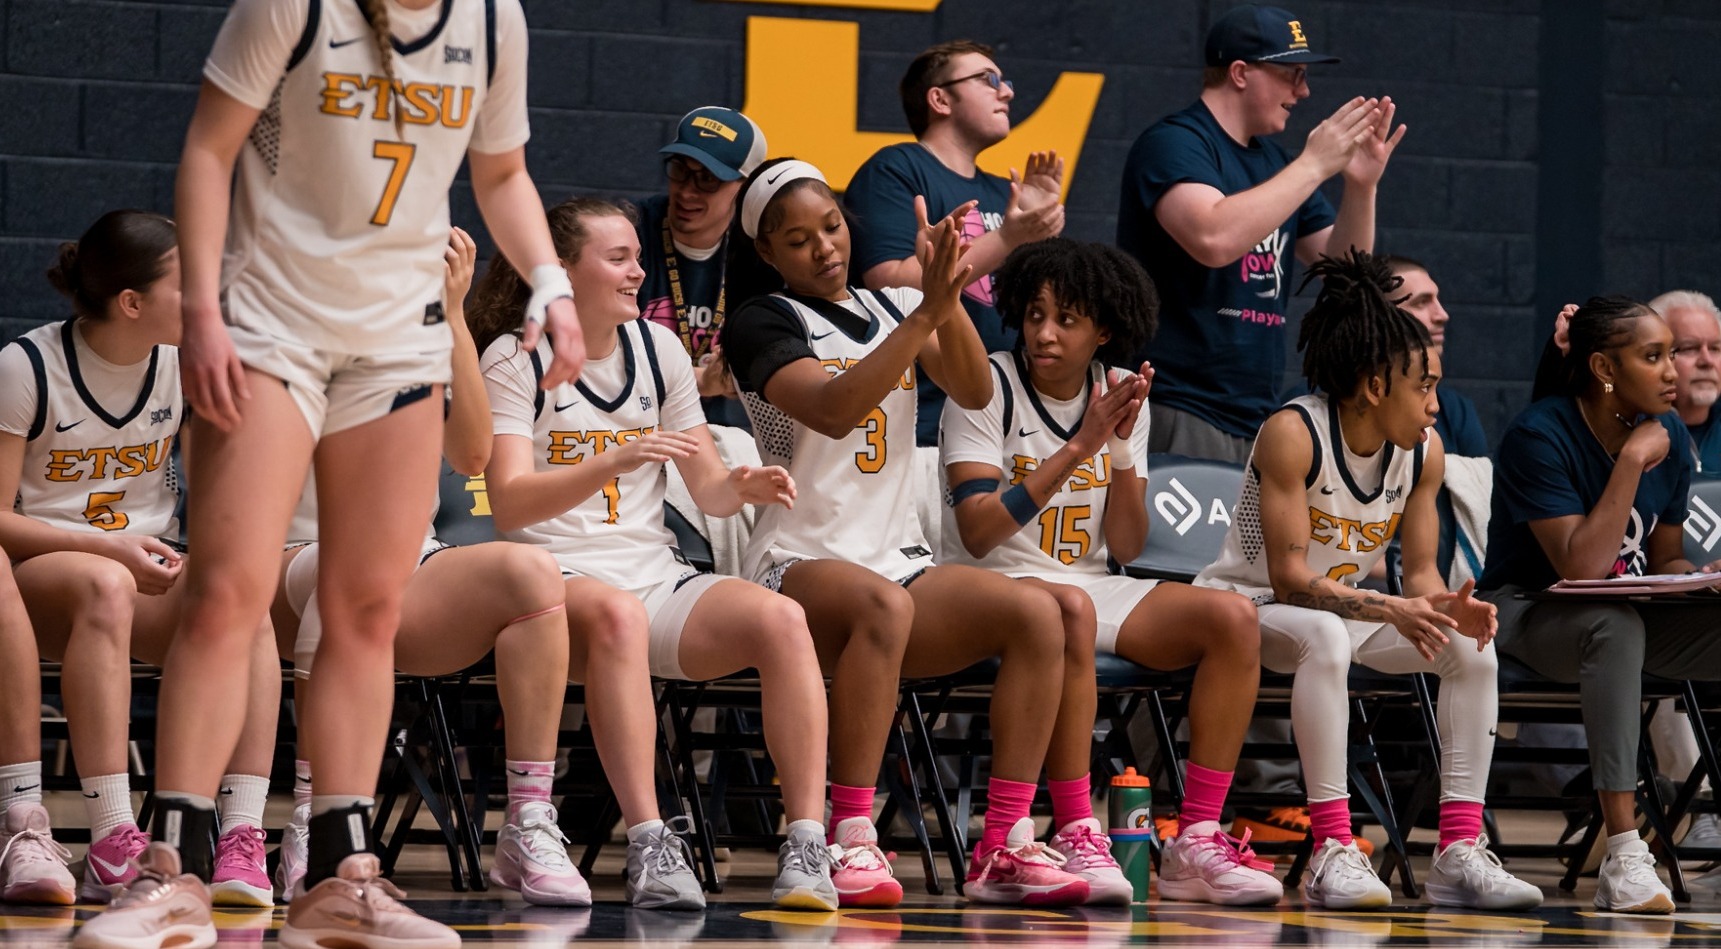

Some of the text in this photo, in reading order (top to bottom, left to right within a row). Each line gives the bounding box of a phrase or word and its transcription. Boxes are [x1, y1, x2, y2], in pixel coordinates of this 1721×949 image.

[319, 72, 475, 129] ETSU
[369, 139, 417, 226] 7
[44, 435, 173, 482] ETSU
[855, 405, 887, 473] 3
[82, 490, 129, 531] 5
[1038, 504, 1091, 565] 15
